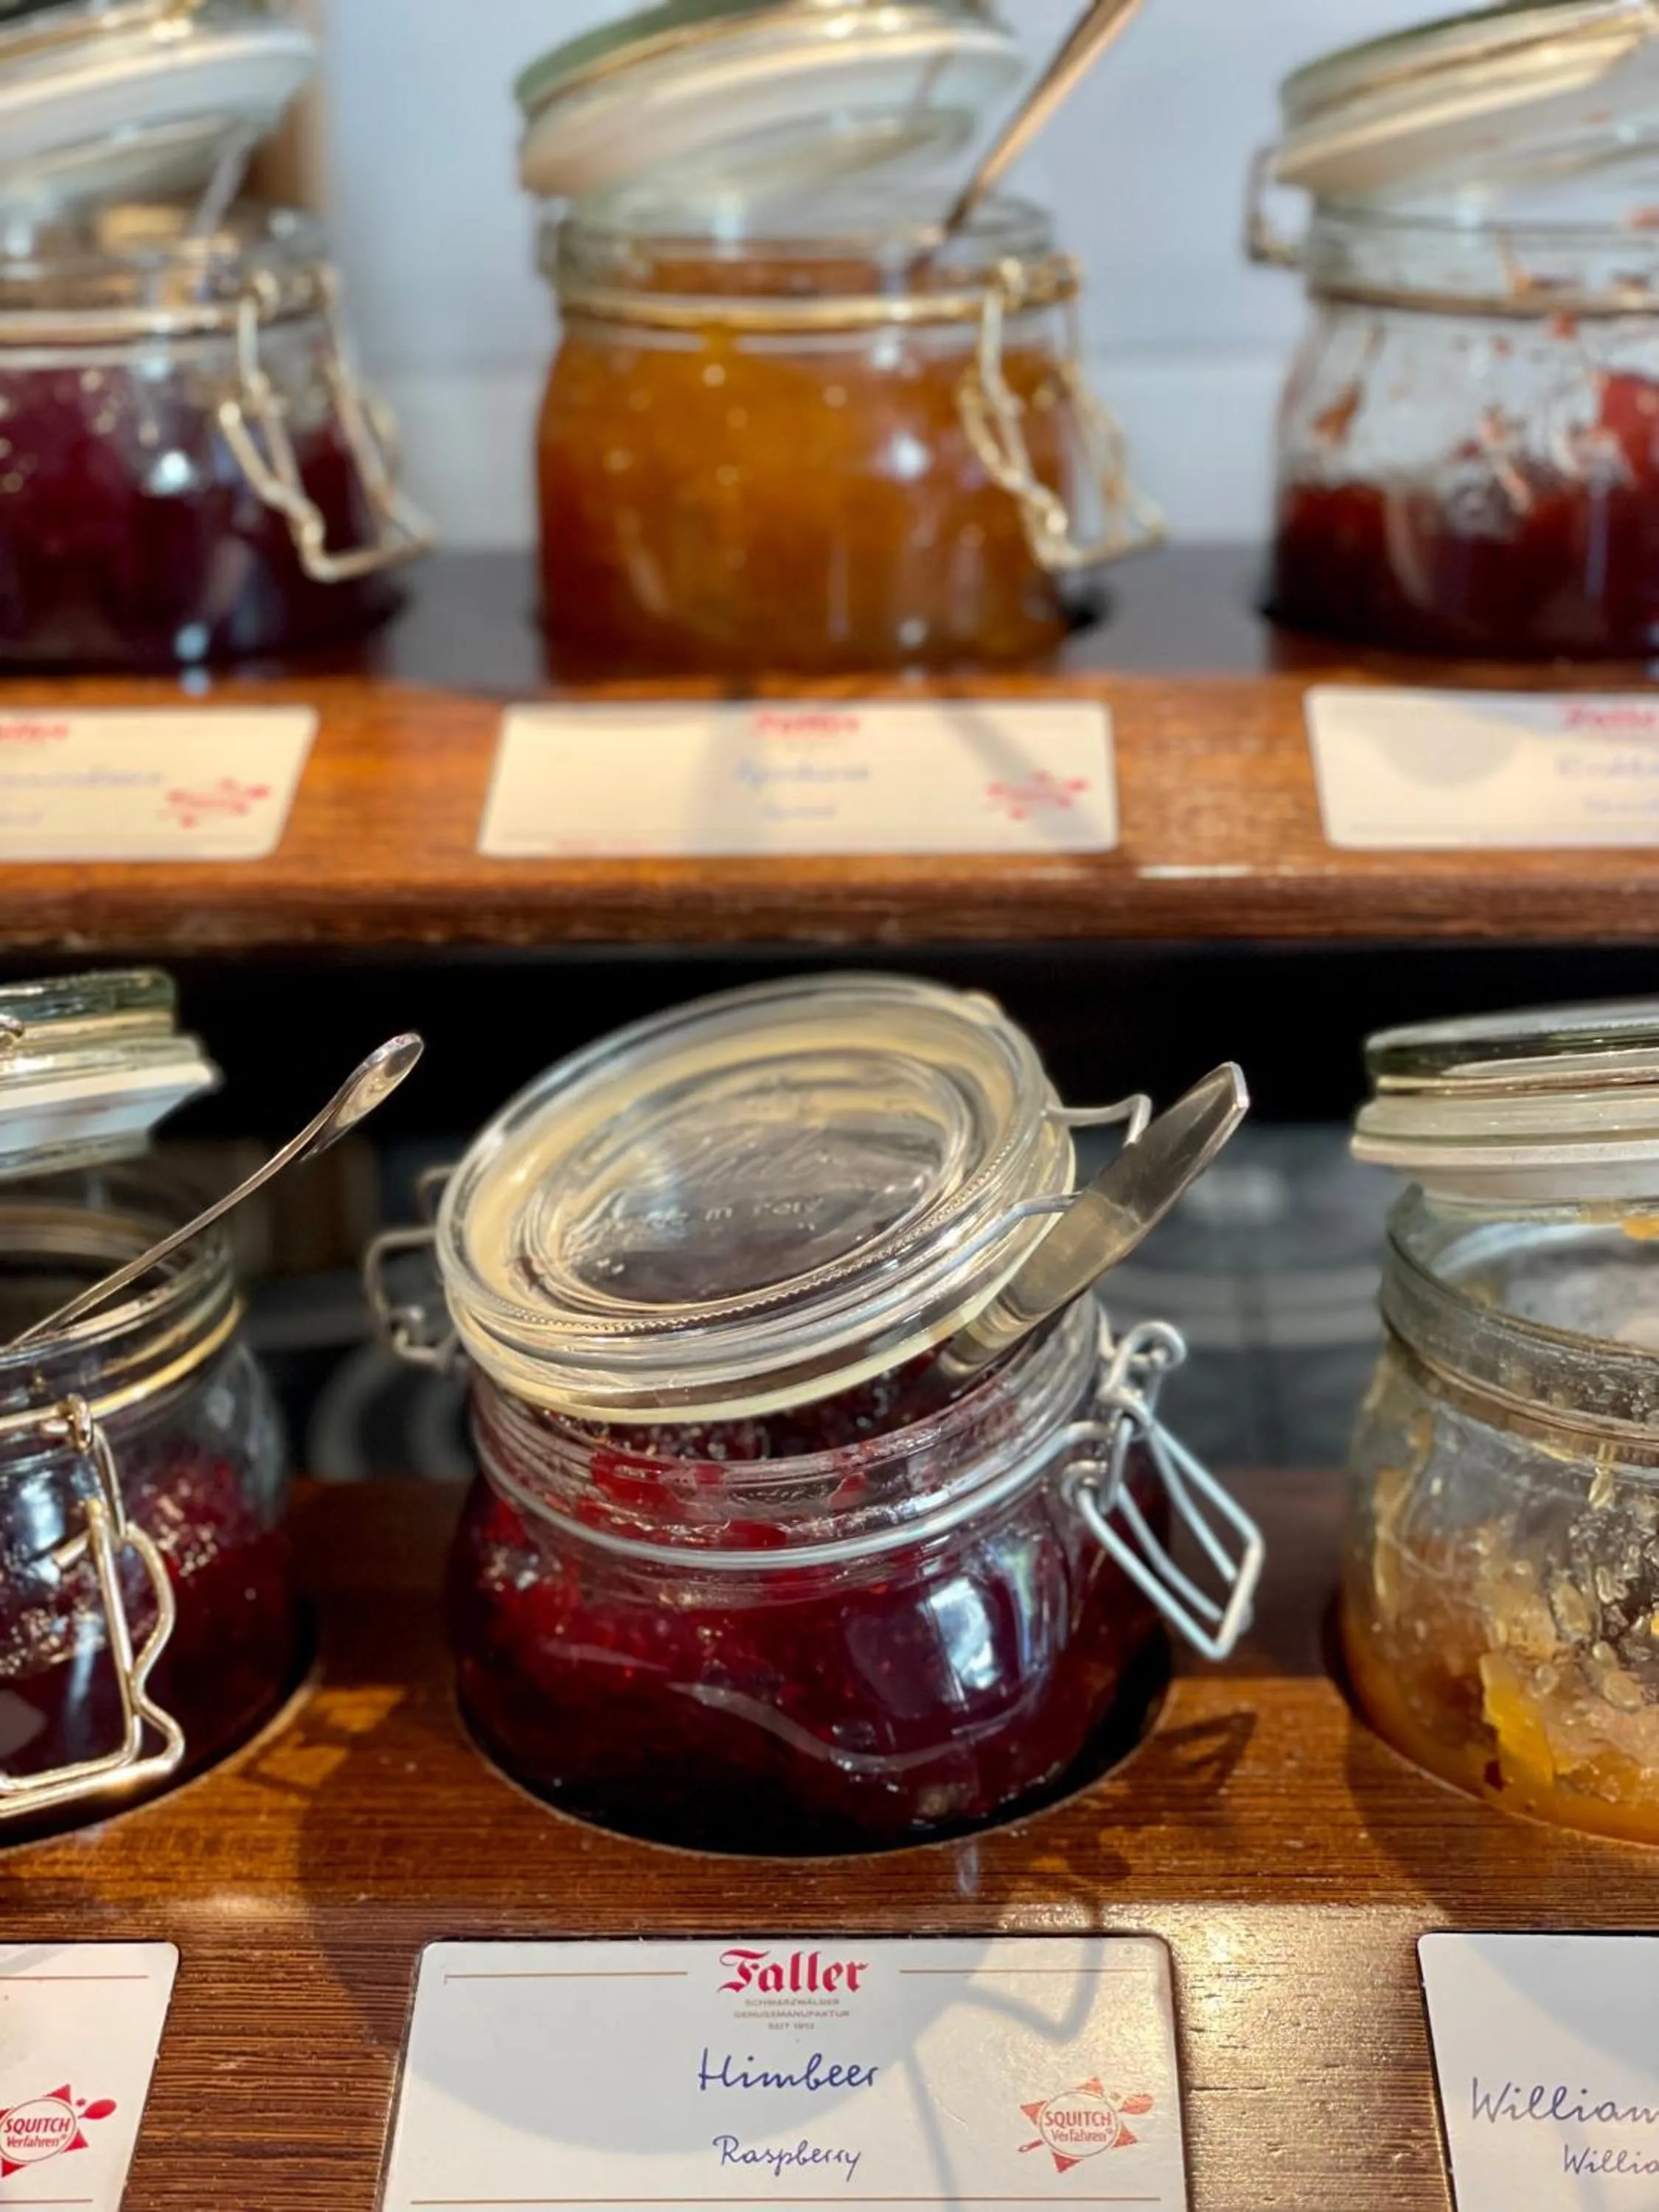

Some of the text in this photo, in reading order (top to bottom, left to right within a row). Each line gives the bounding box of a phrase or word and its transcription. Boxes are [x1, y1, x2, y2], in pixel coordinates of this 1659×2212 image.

[717, 1949, 870, 1993] Faller
[698, 2047, 880, 2090] Himbeer
[3, 2117, 72, 2135] SQUITCH
[1044, 2110, 1113, 2129] SQUITCH
[712, 2135, 863, 2183] Raspberry
